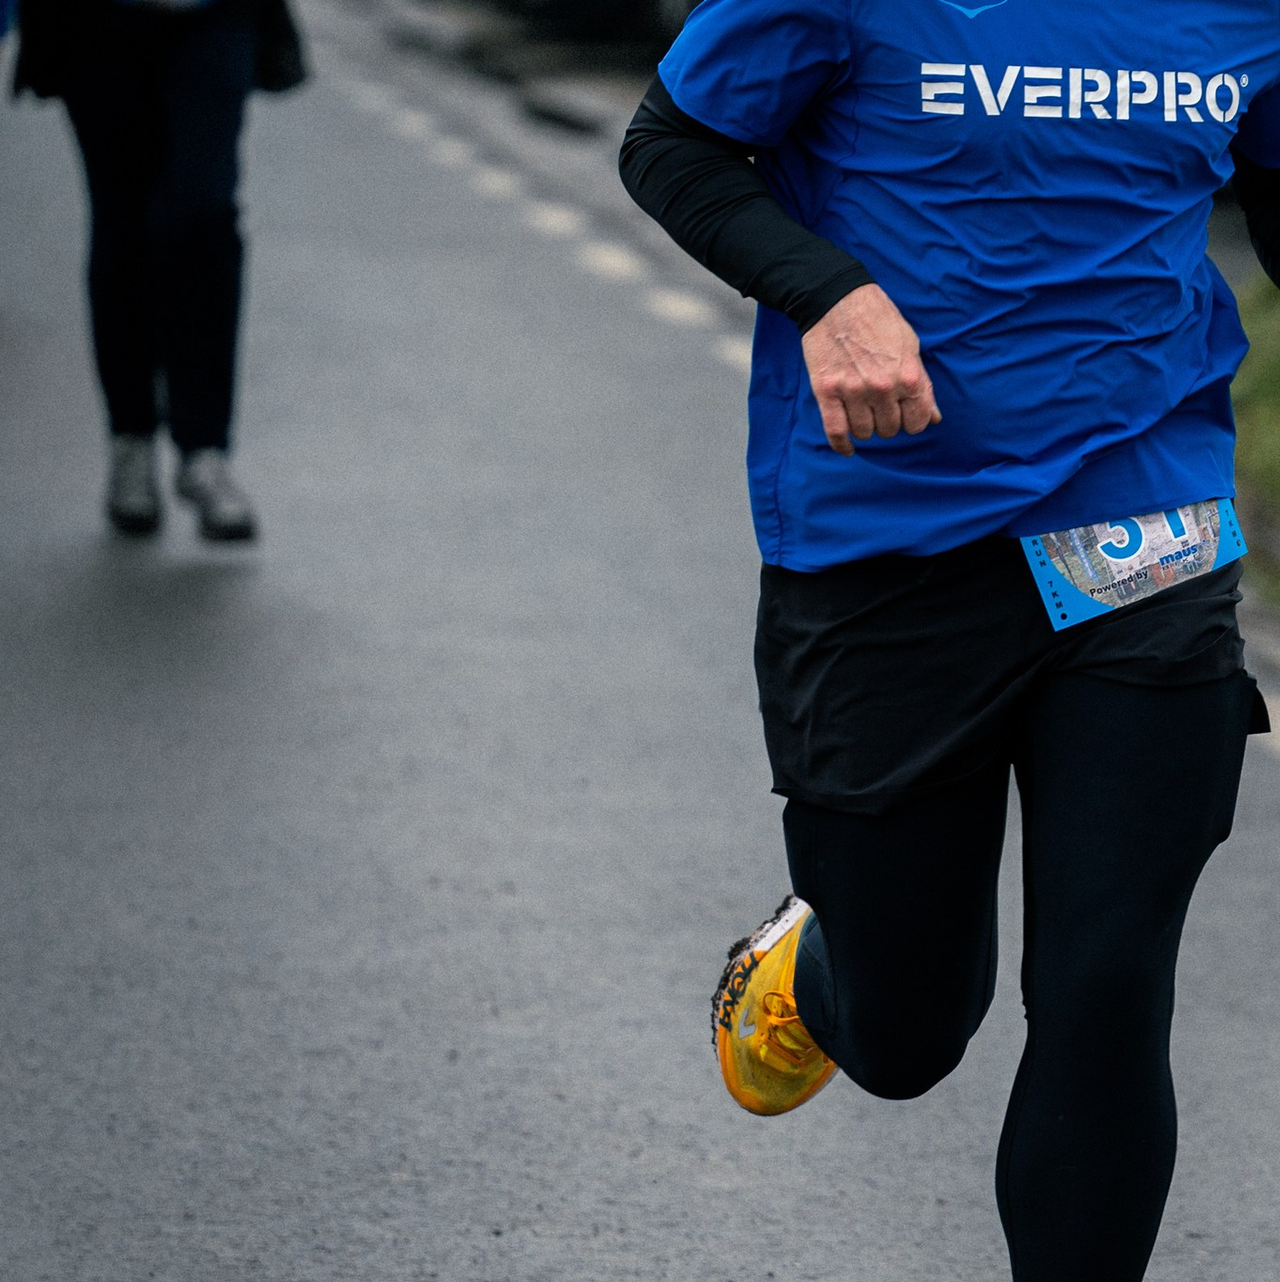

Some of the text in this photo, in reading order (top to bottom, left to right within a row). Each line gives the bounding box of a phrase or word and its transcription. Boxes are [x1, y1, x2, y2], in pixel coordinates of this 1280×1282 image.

[1158, 544, 1198, 566] maus
[1032, 538, 1064, 609] RUN 7KM
[1089, 569, 1149, 597] Powered by
